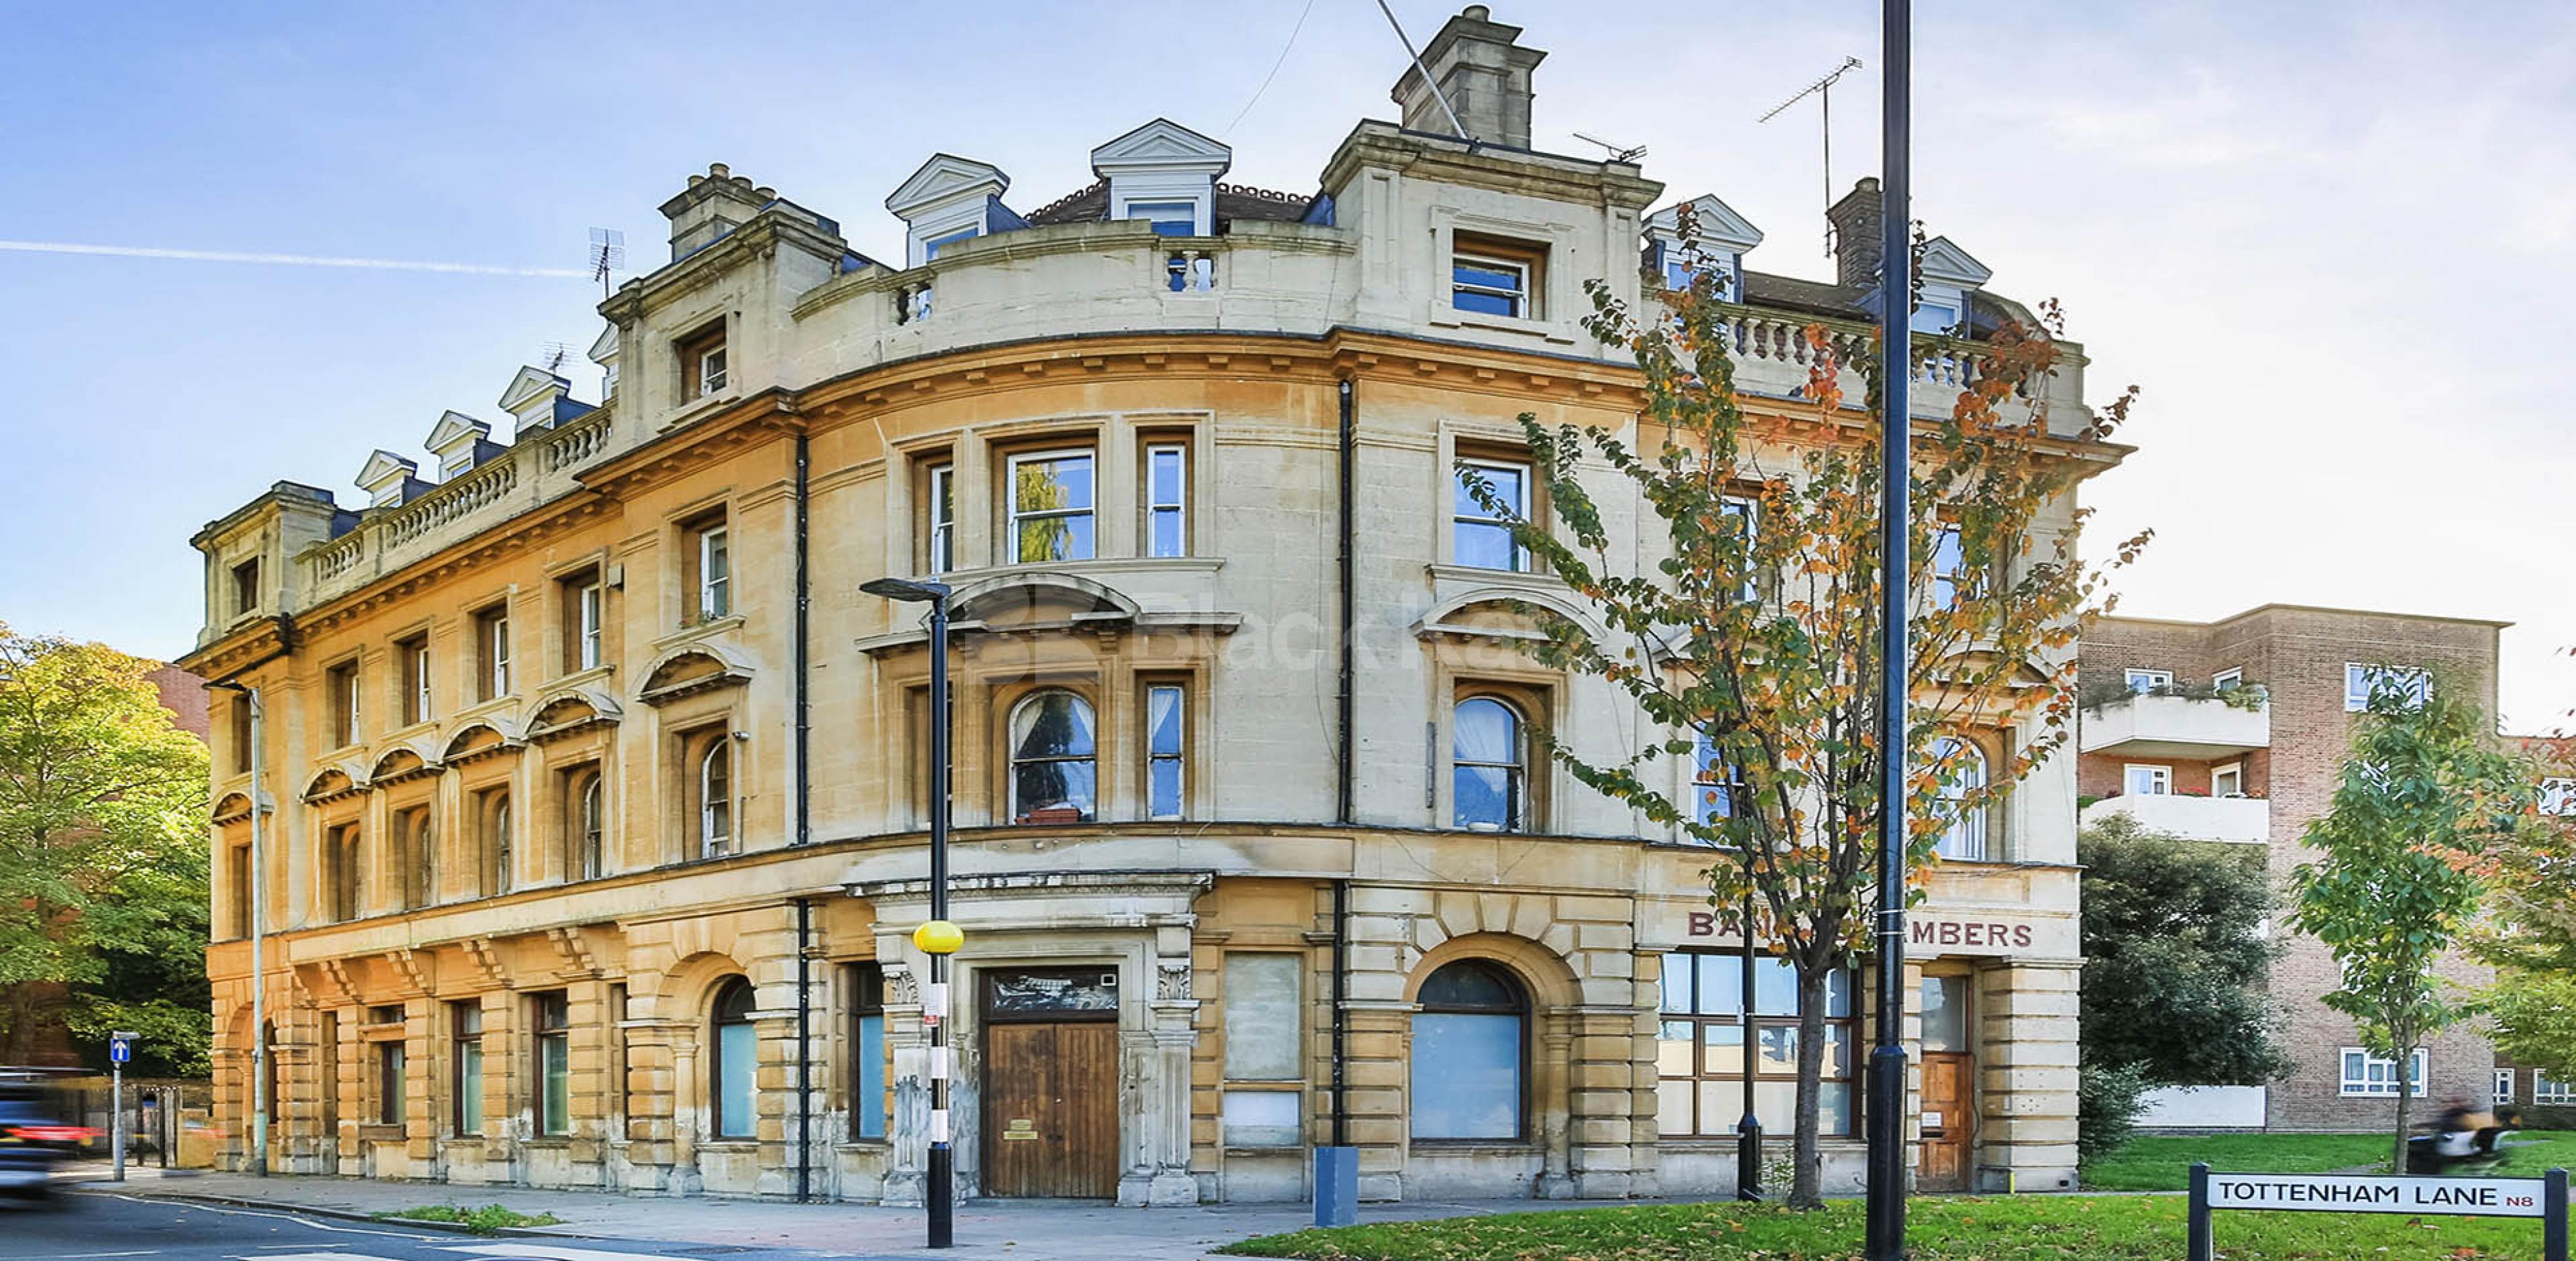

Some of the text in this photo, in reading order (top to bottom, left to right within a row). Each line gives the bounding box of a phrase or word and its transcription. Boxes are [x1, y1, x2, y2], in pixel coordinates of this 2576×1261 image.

[1688, 912, 2033, 948] BAN MBERS
[2218, 1182, 2534, 1207] TOTTENHAM LANE N8
